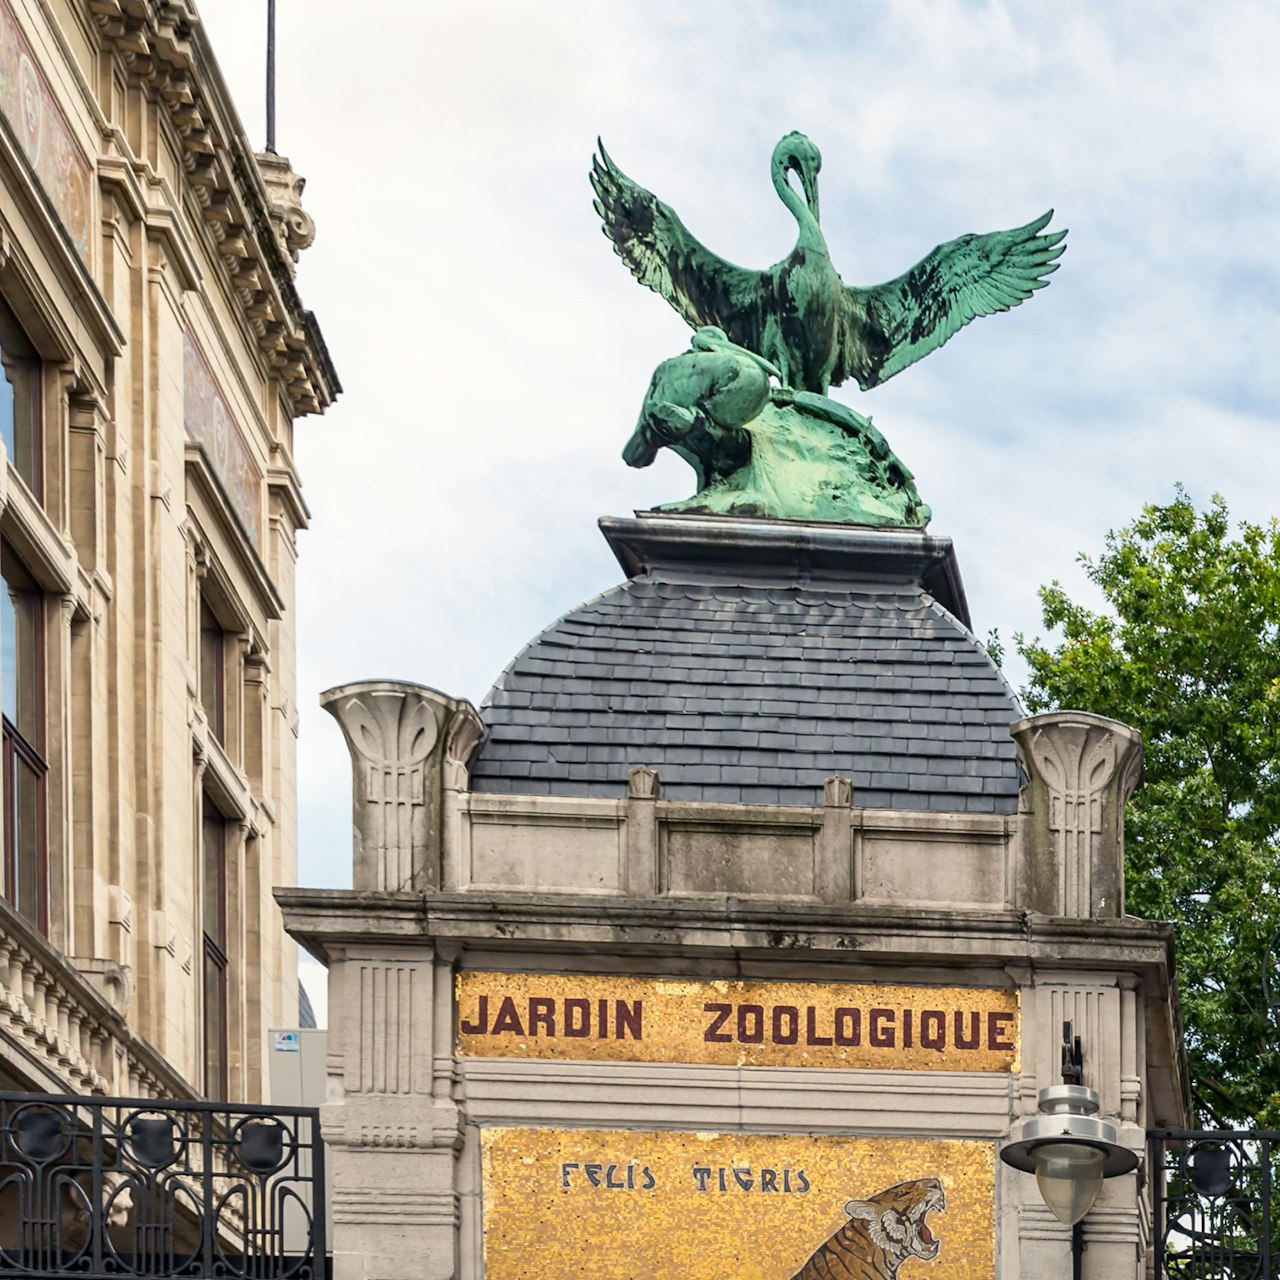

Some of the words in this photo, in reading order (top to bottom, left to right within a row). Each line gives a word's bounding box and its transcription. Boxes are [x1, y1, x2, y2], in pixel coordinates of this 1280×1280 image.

[461, 995, 643, 1041] JARDIN
[704, 1002, 1015, 1051] ZOOLOGIQUE
[562, 1162, 656, 1190] FELIS
[693, 1166, 810, 1193] TIGRIS
